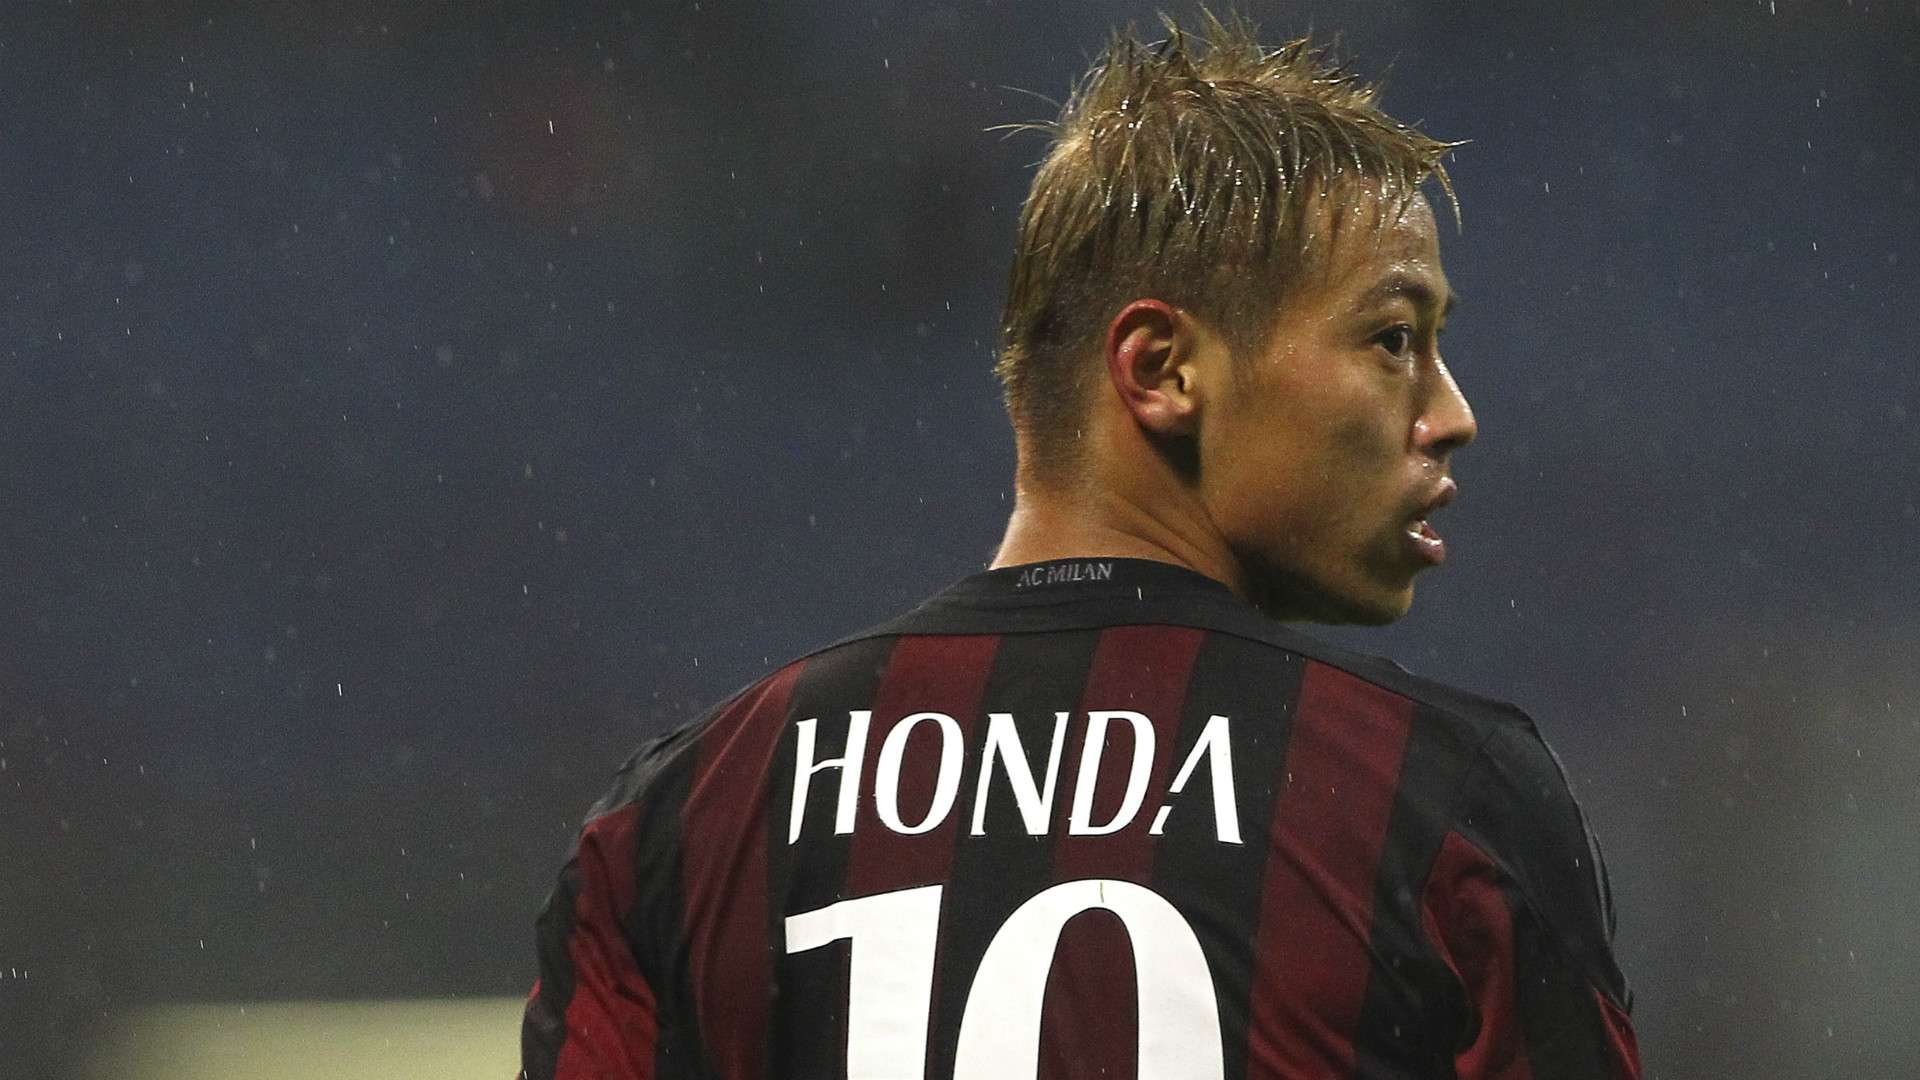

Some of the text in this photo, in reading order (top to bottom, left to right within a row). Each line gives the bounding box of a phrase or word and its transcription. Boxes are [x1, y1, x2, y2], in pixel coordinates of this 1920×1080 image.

[1016, 562, 1112, 587] AC MILAN
[788, 711, 1243, 845] HONDA
[785, 879, 1225, 1080] 10
